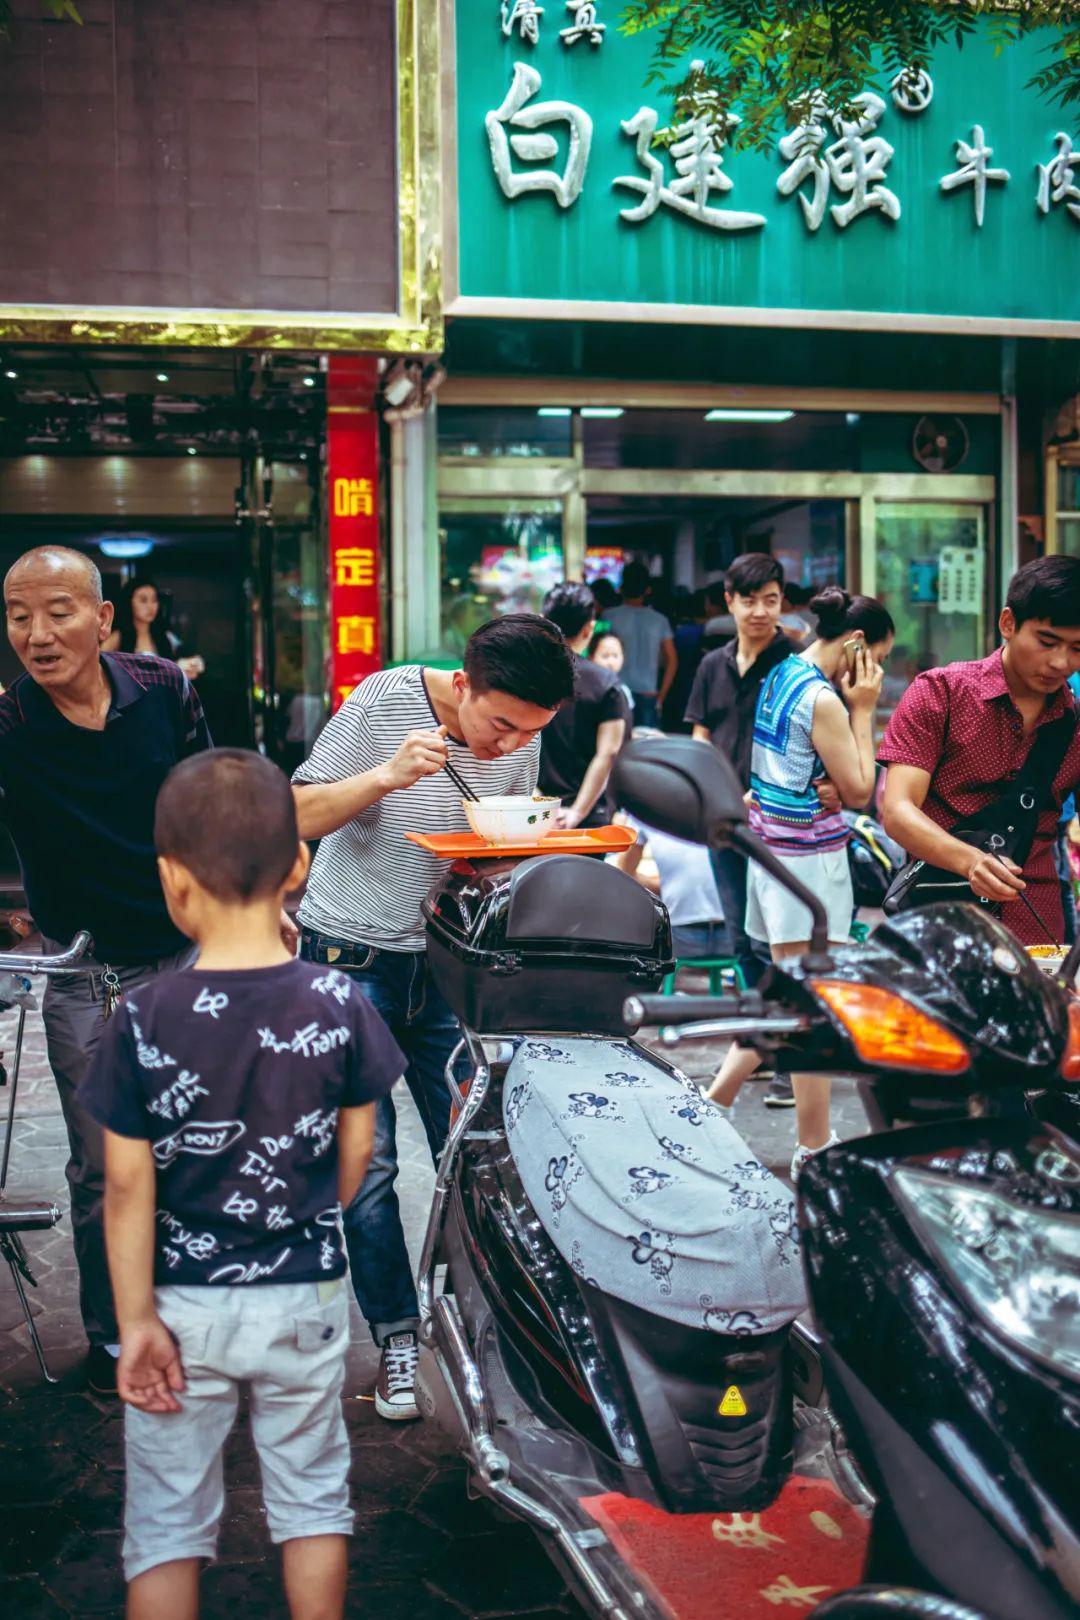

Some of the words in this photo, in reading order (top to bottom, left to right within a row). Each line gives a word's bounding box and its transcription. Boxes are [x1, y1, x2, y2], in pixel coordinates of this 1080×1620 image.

[501, 0, 606, 44] 清真
[335, 477, 375, 703] 啃定真
